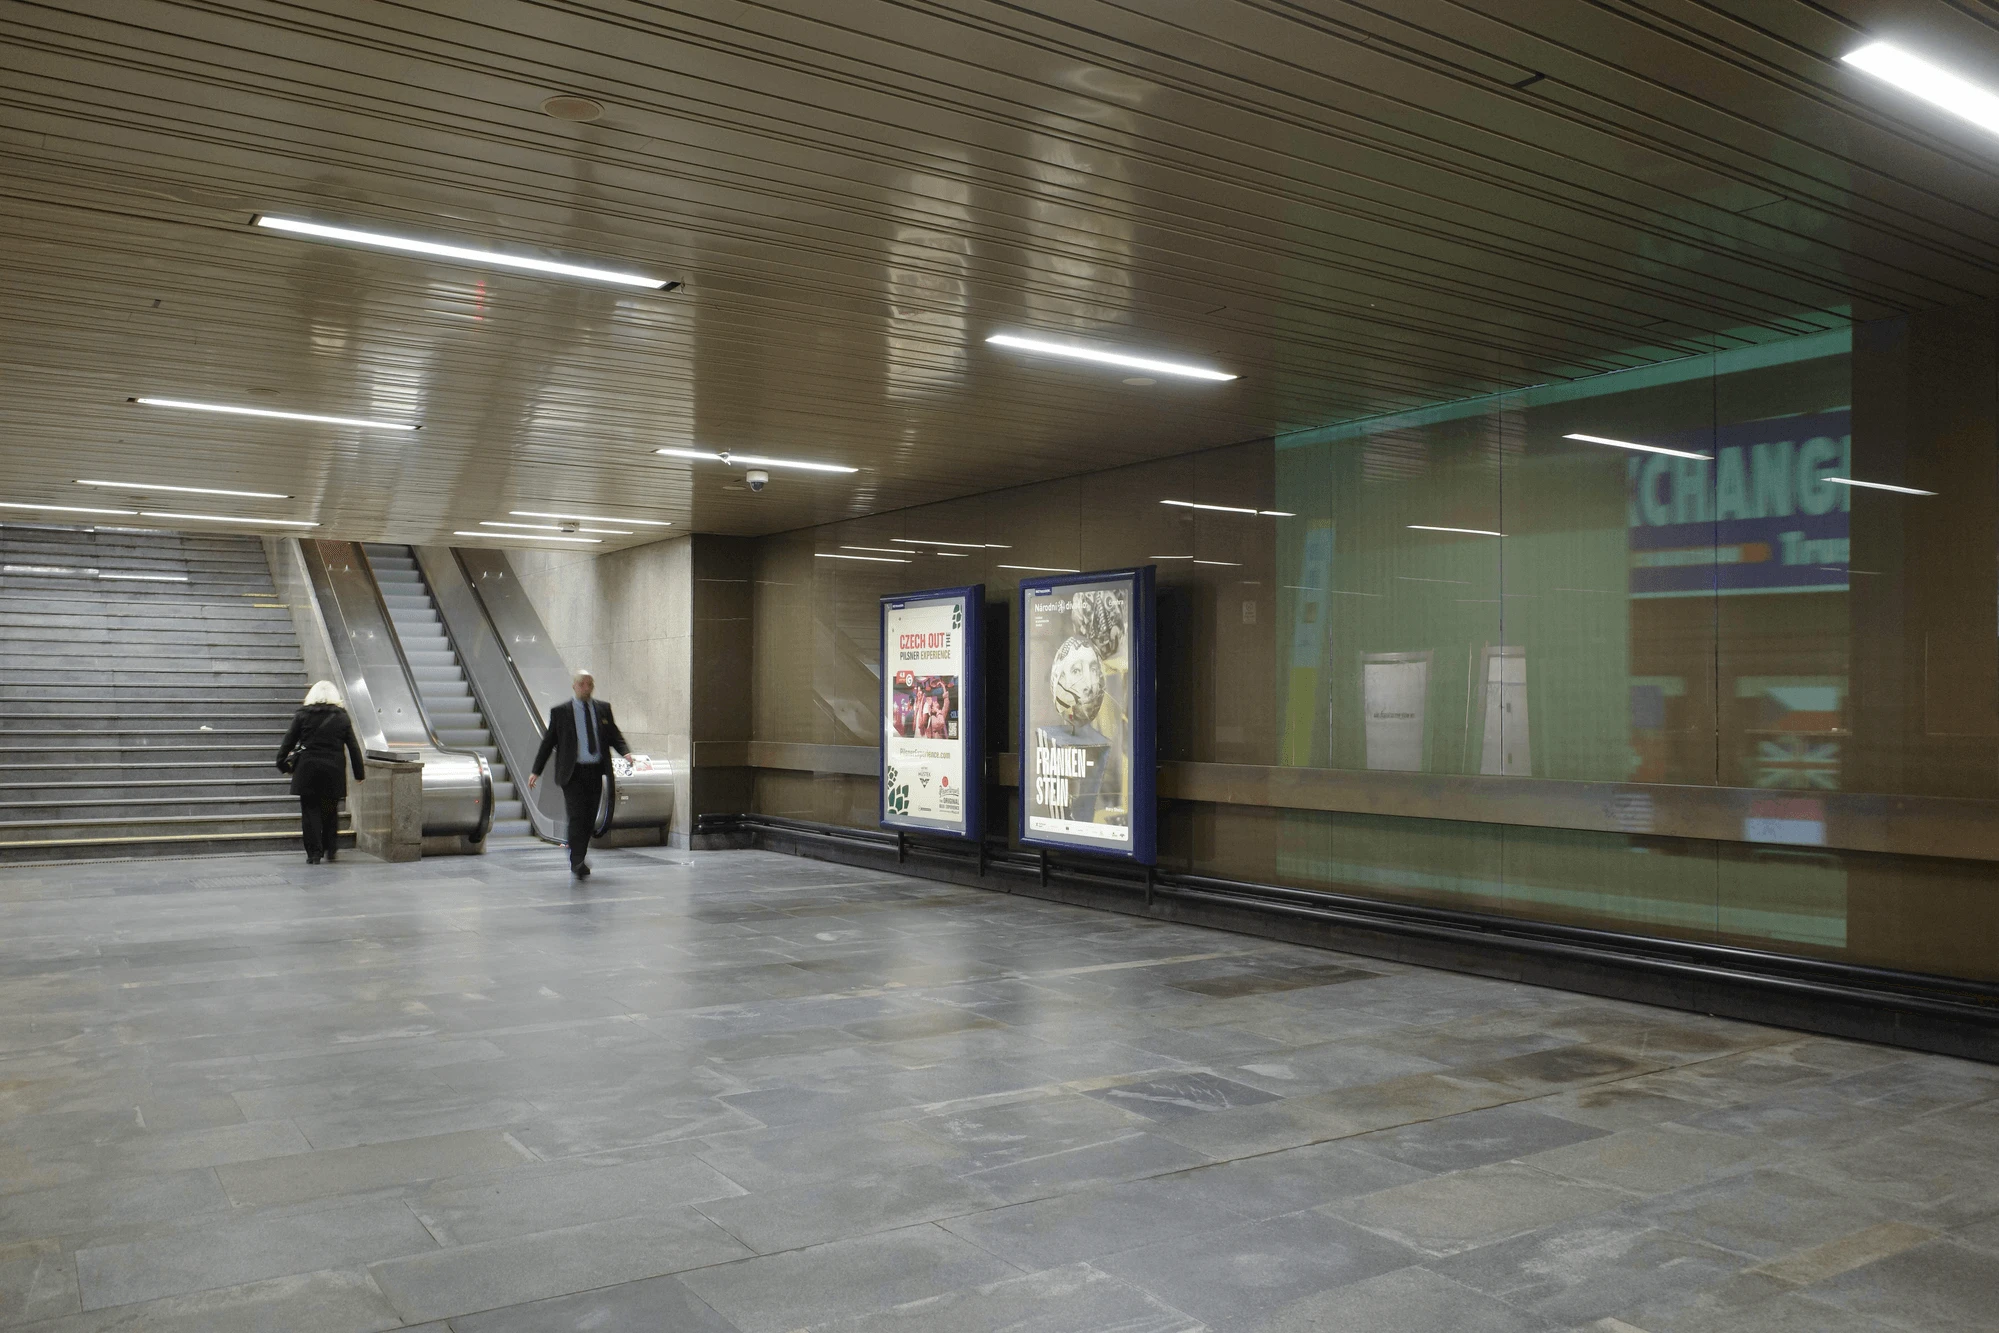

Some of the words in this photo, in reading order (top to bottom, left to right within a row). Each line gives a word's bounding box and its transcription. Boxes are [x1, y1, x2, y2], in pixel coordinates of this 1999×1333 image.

[1034, 602, 1058, 613] Národní
[900, 633, 926, 650] CZECH
[928, 632, 945, 649] OUT
[900, 651, 920, 661] PILSNER
[921, 650, 951, 660] EXPERIENCE
[1036, 747, 1095, 778] FRANKEN-
[1036, 776, 1069, 807] STEIN
